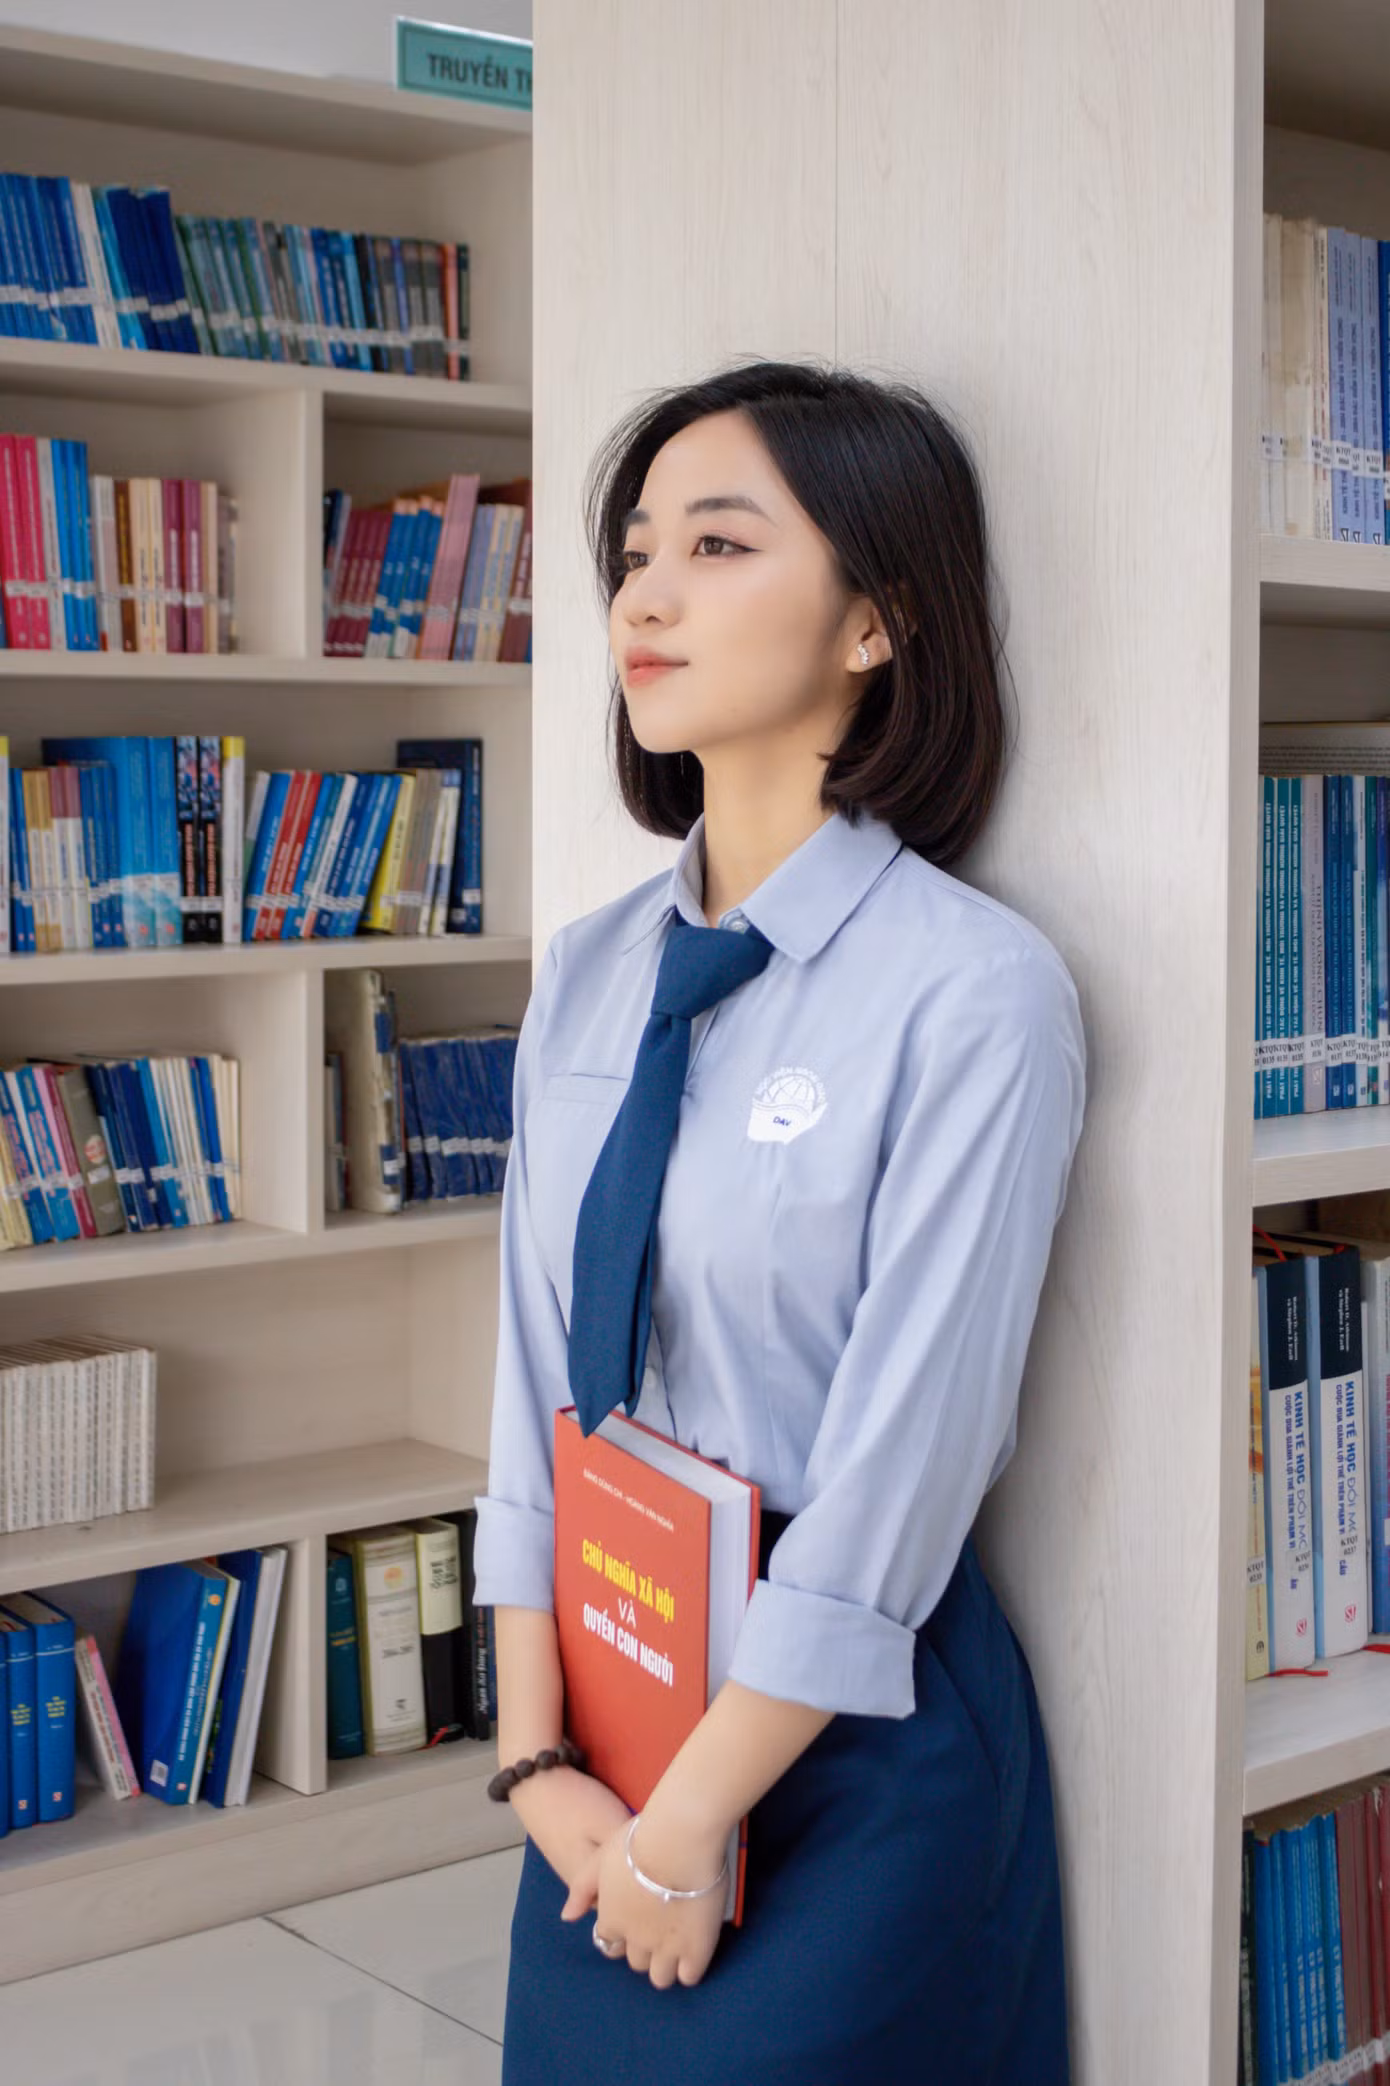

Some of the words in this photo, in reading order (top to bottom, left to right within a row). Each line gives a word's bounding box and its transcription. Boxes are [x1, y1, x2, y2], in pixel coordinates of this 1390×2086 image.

[1295, 1391, 1304, 1428] KINH
[1345, 1380, 1355, 1417] KINH
[583, 1538, 603, 1574] CHỦ
[605, 1552, 636, 1597] NGHĨA
[639, 1574, 653, 1608] XÃ
[656, 1586, 674, 1624] HỘI
[618, 1596, 636, 1630] VÀ
[617, 1627, 638, 1662] CON
[640, 1641, 674, 1688] NGƯỜI
